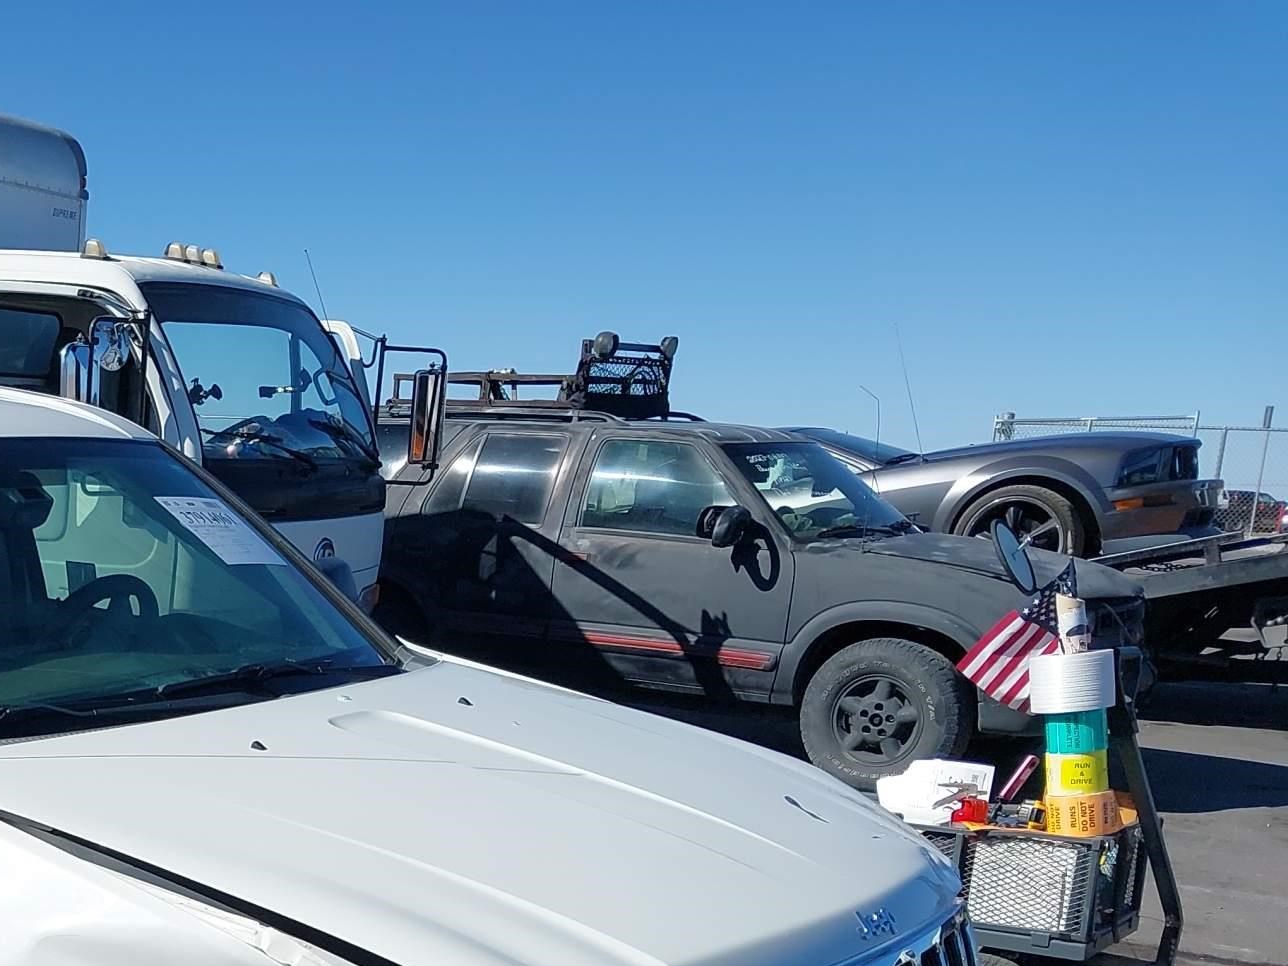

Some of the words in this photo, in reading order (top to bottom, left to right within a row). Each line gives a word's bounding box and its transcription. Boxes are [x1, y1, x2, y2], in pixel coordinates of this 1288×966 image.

[1080, 801, 1088, 817] NOT
[1081, 819, 1089, 832] DO
[855, 907, 896, 941] Jeep
